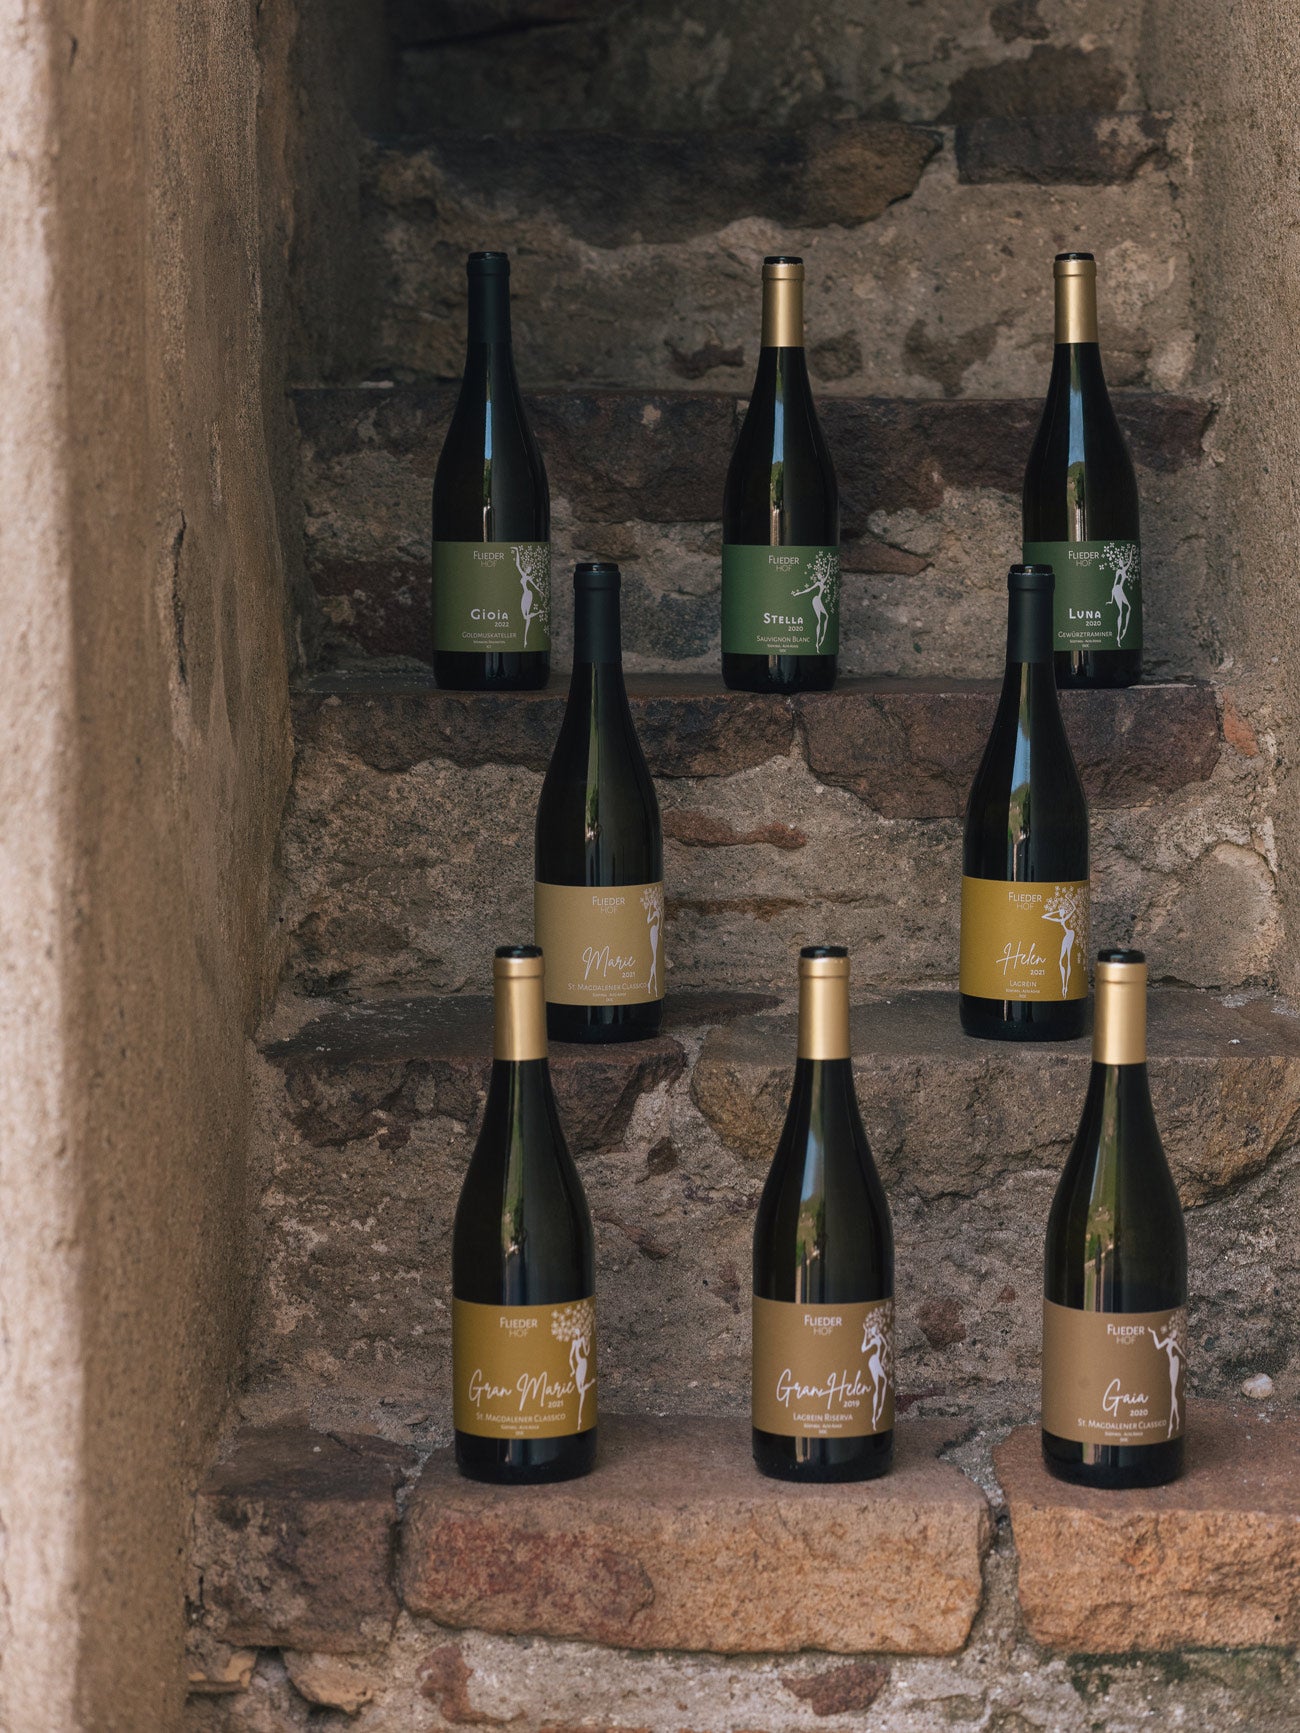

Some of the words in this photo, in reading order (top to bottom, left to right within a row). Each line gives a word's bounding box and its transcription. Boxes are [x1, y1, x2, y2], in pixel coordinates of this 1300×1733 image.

[473, 551, 504, 560] FLIEDER
[768, 555, 800, 564] FLIEDER
[1068, 551, 1099, 559] FLIEDER
[763, 613, 804, 624] STELLA
[1069, 608, 1101, 619] LUNA
[592, 896, 625, 905] FLIEDER
[1008, 892, 1042, 902] FLIEDER
[582, 945, 636, 980] Marie
[996, 941, 1046, 975] Helen
[577, 983, 620, 991] MAGDALENER
[499, 1317, 538, 1328] FLIEDER
[804, 1315, 842, 1327] FLIEDER
[509, 1329, 528, 1337] HOF
[1107, 1324, 1145, 1335] FLIEDER
[1116, 1336, 1136, 1345] HOF
[469, 1369, 512, 1407] Gran
[516, 1371, 575, 1411] Marie
[776, 1369, 822, 1408] Gran
[822, 1369, 871, 1410] Helen
[1102, 1378, 1149, 1417] Gaia
[843, 1400, 860, 1408] 2019
[486, 1413, 533, 1423] MAGDALENER
[534, 1413, 566, 1422] CLASSICO
[793, 1413, 823, 1421] LAGREIN
[824, 1413, 853, 1421] RISERVA
[1088, 1419, 1137, 1429] MAGDALENER
[1138, 1419, 1167, 1429] CLASSICO
